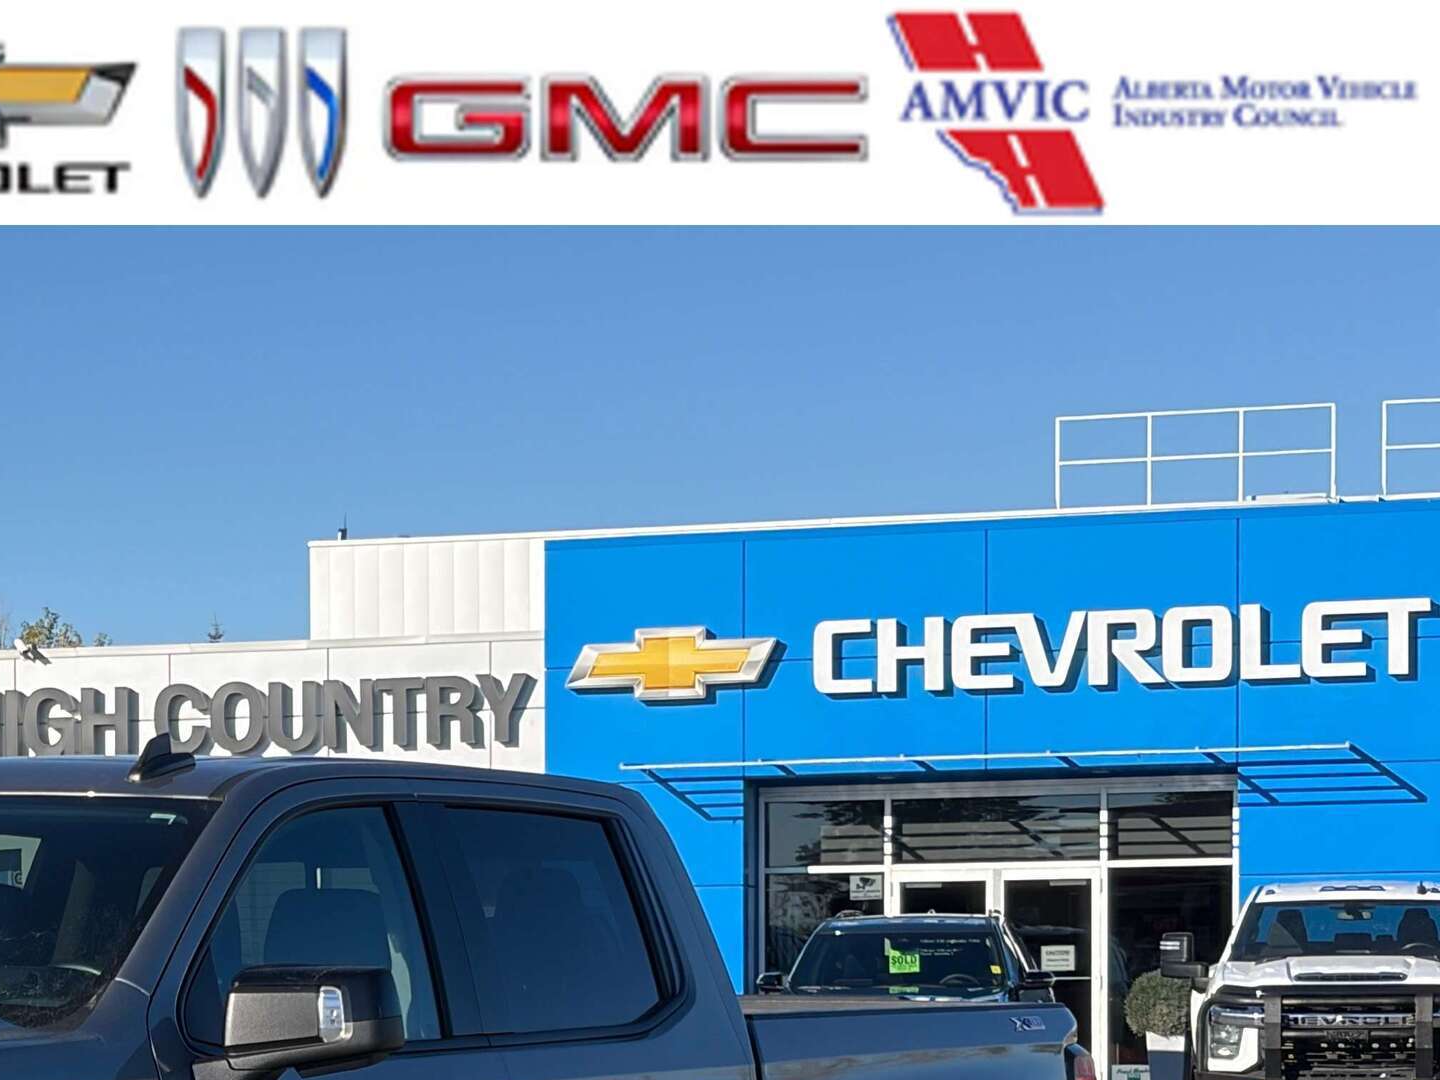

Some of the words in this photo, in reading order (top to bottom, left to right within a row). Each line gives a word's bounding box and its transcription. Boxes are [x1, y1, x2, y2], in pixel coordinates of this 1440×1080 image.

[812, 597, 1432, 695] CHEVROLET
[154, 672, 537, 756] COUNTRY
[891, 956, 917, 966] SOLD
